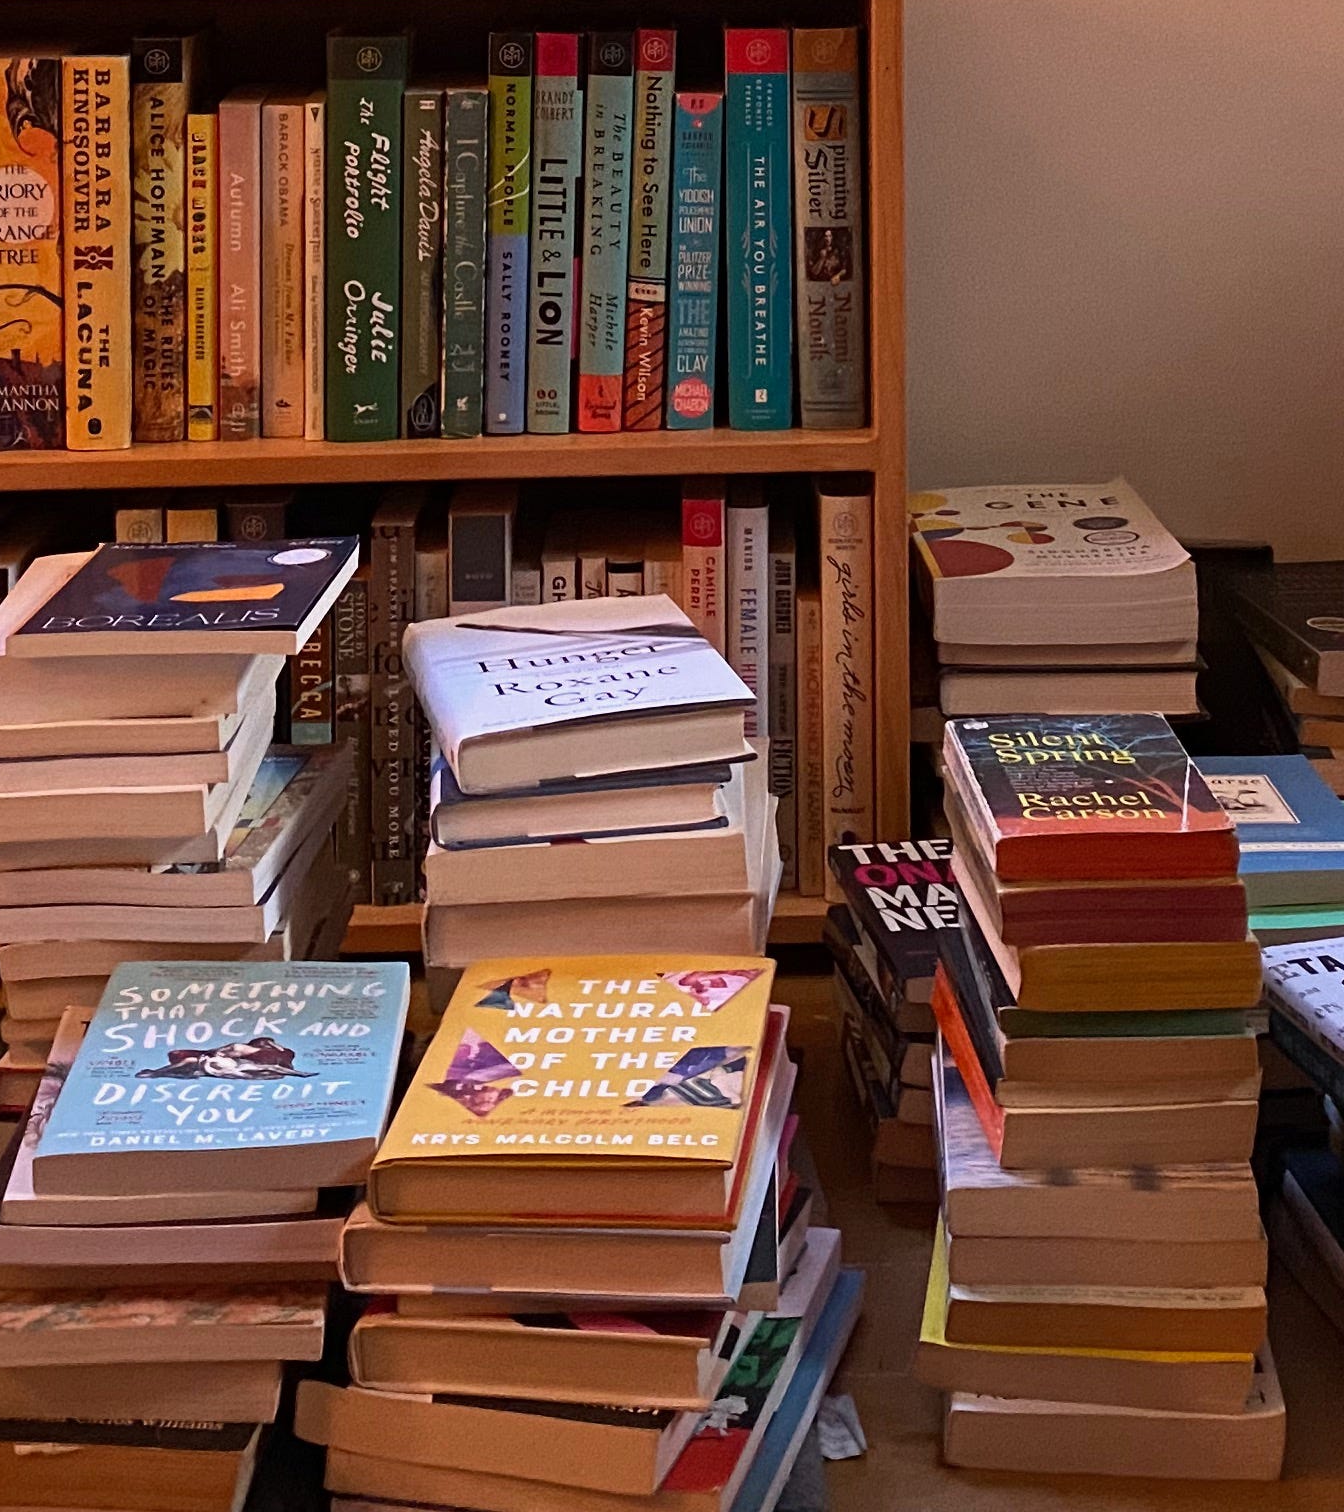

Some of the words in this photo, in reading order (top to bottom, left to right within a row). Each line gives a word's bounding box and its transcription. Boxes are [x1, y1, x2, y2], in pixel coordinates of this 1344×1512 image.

[506, 83, 515, 155] NORMAL
[73, 68, 90, 233] KINGSOLVER
[95, 69, 112, 232] BARBARA
[3, 164, 28, 175] THE
[754, 157, 765, 188] THE
[504, 164, 514, 227] PEOPLE
[539, 157, 567, 240] LITTLE
[15, 206, 38, 218] THE
[754, 199, 765, 227] AIR
[542, 249, 559, 264] &
[754, 238, 765, 274] YOU
[502, 251, 512, 298] SALLY
[537, 271, 564, 346] LION
[337, 279, 365, 375] Orringer
[371, 292, 394, 362] Julie
[754, 285, 766, 366] BREATHE
[76, 281, 93, 413] LACUNA
[99, 325, 109, 368] THE
[501, 306, 511, 382] ROONEY
[985, 496, 1120, 509] GENE
[690, 569, 700, 608] PERRI
[706, 557, 716, 618] CAMILLE
[41, 607, 280, 630] BOREALIS
[494, 666, 679, 696] Roxane
[544, 687, 648, 706] Gay
[989, 731, 1106, 749] Silent
[996, 749, 1136, 765] Spring
[1017, 792, 1152, 807] Rachel
[1023, 807, 1166, 821] Carson
[114, 981, 386, 1007] SOMETHING
[578, 979, 659, 994] THE
[114, 1003, 212, 1021] THAT
[224, 1001, 306, 1015] MAY
[505, 1002, 712, 1017] NATURAL
[102, 1017, 287, 1052] SHOCK
[298, 1022, 370, 1037] AND
[505, 1027, 697, 1042] MOTHER
[509, 1053, 567, 1069] OF
[591, 1051, 679, 1069] THE
[93, 1081, 351, 1105] DISCREDIT
[510, 1079, 655, 1097] CHILD
[166, 1105, 254, 1125] YOU
[90, 1134, 180, 1147] DANIEL
[194, 1132, 221, 1143] M.
[237, 1128, 331, 1141] LAVERY
[411, 1134, 479, 1145] KRYS
[495, 1134, 632, 1145] MALCOLM
